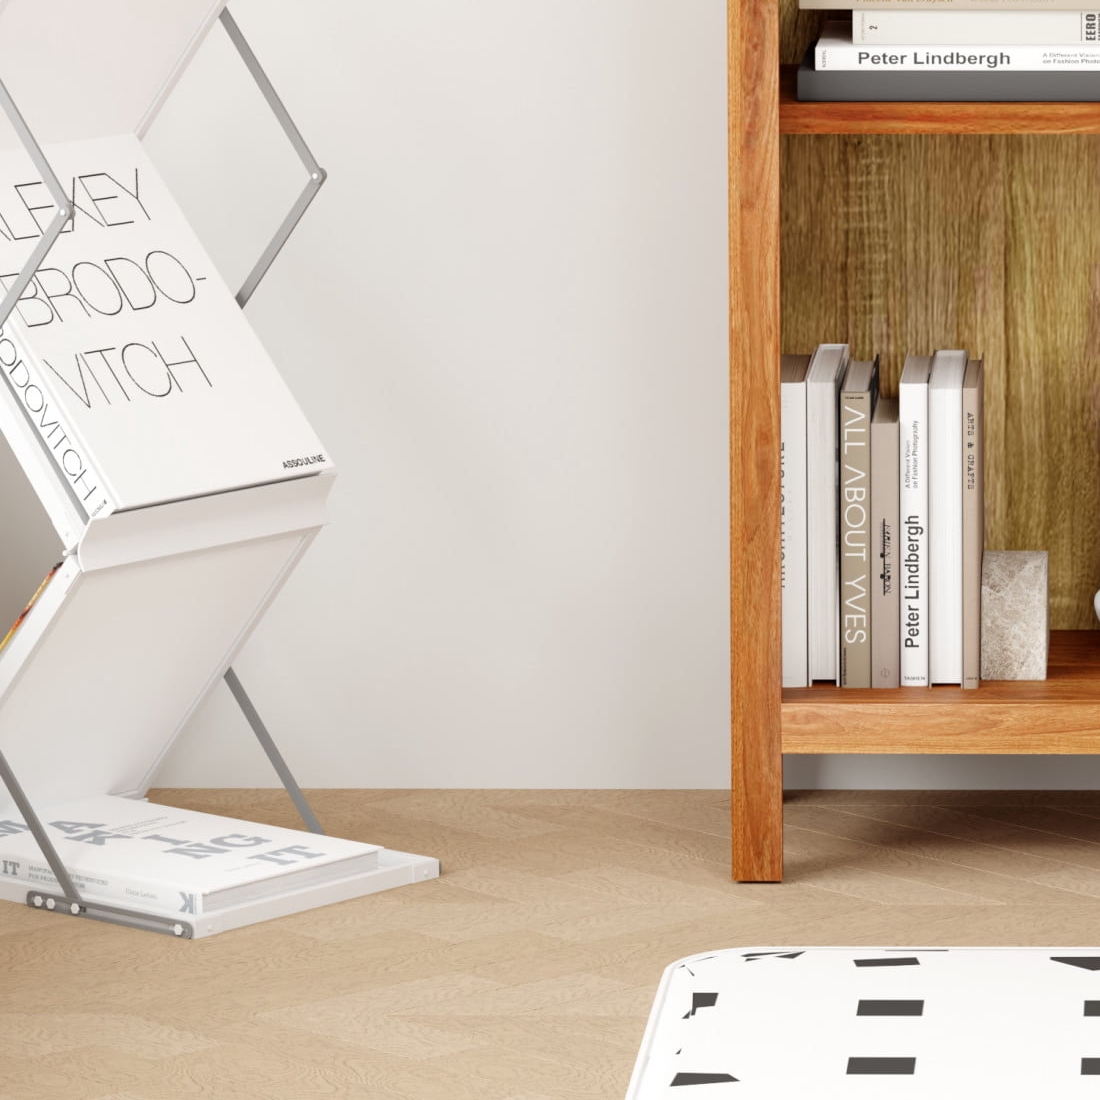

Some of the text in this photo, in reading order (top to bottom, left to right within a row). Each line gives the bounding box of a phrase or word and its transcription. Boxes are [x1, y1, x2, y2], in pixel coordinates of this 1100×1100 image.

[1085, 13, 1097, 41] EERO
[858, 50, 1011, 69] Peter Lindbergh
[0, 168, 151, 241] LEXEY
[0, 250, 207, 328] BRODO-
[43, 336, 212, 408] VITCH
[0, 326, 97, 501] ODOVITCH
[844, 405, 866, 455] ALL
[912, 420, 920, 457] Photography
[967, 412, 975, 436] ARTS
[282, 454, 326, 469] ASSOULINE
[967, 441, 975, 449] &
[844, 464, 867, 562] ABOUT
[904, 515, 924, 649] Peter Lindbergh
[844, 574, 867, 645] YVES
[2, 860, 20, 876] IT
